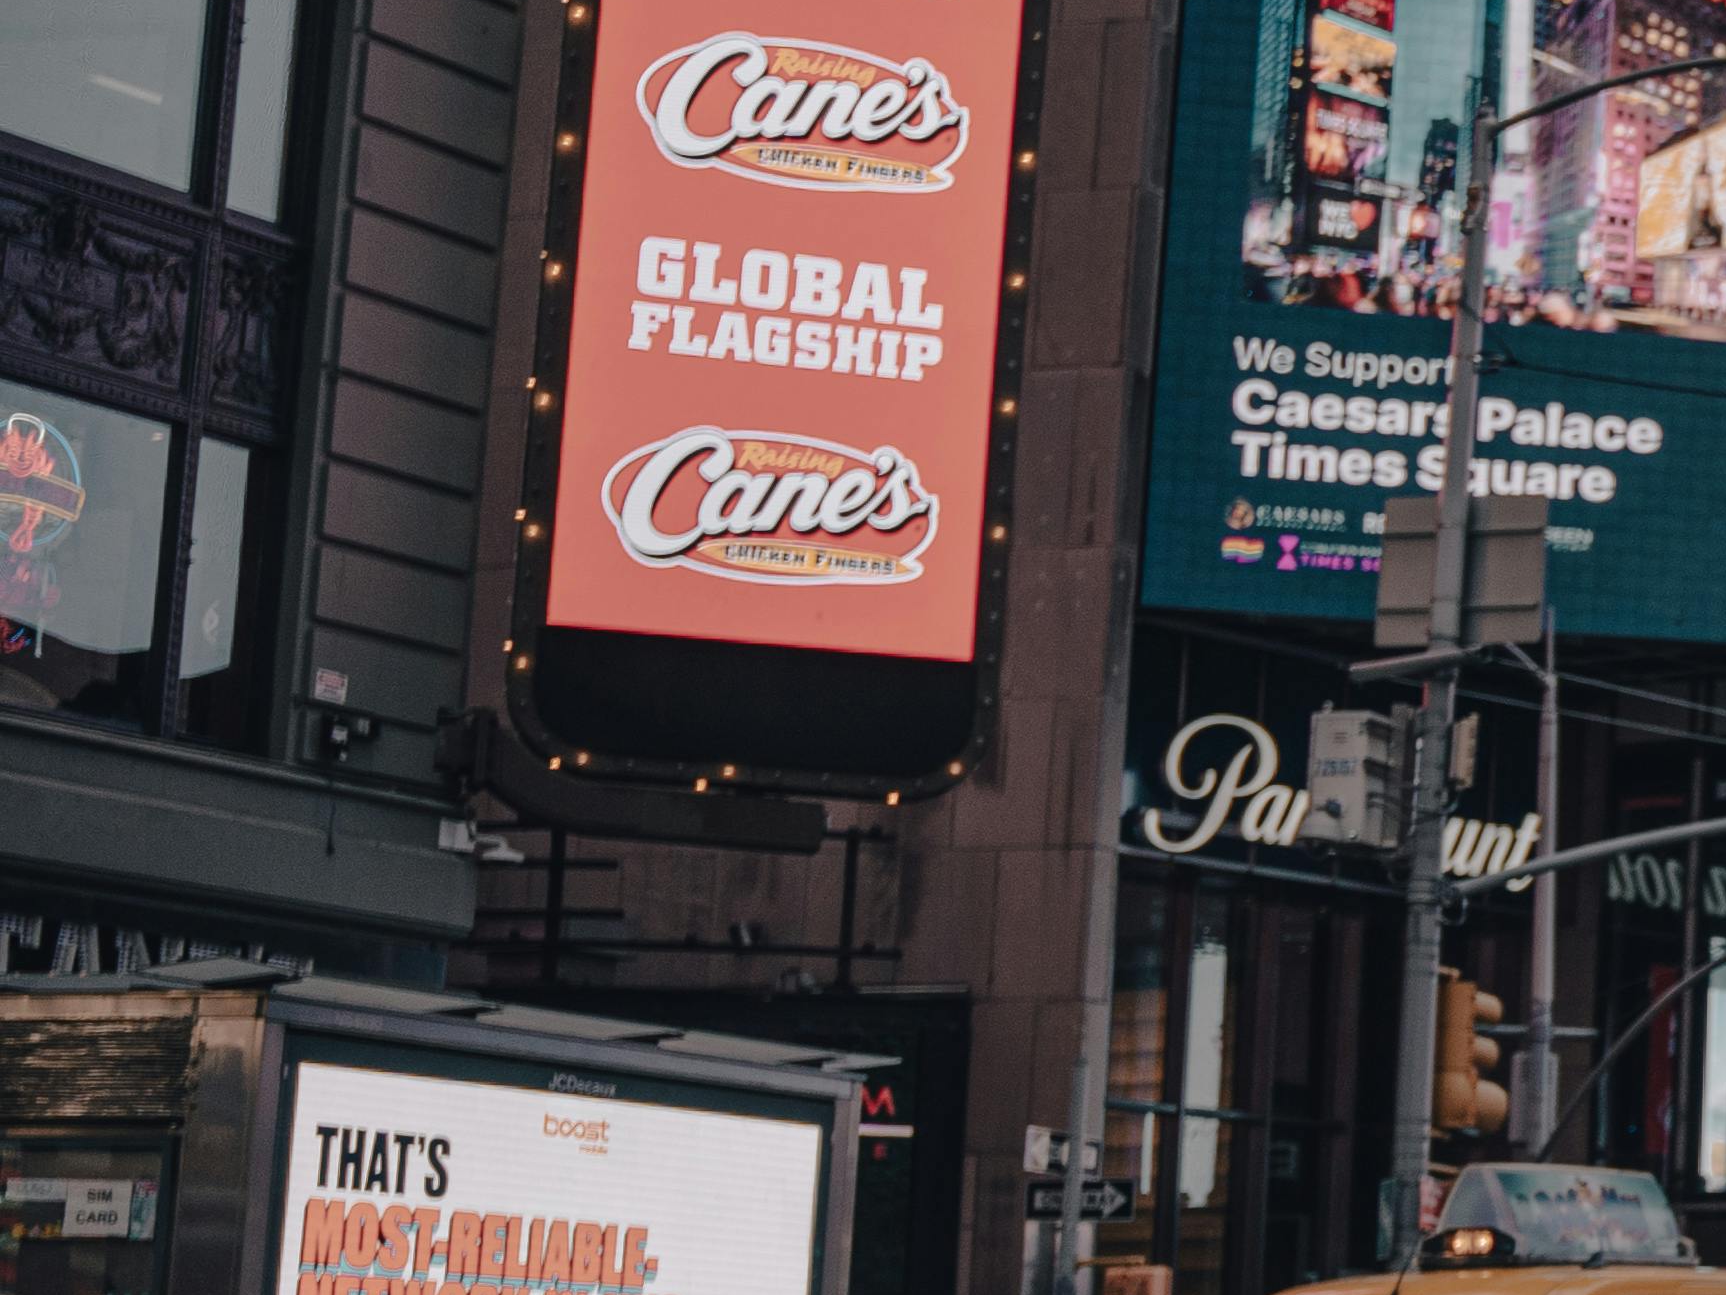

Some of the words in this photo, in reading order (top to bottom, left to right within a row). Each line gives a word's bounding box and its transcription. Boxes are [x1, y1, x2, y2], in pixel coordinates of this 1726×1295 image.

[655, 38, 961, 158] Cane's
[771, 47, 879, 89] Raising
[636, 236, 944, 330] GLOBAL
[627, 299, 943, 382] FLAGSHIP
[1231, 334, 1297, 375] We
[1231, 377, 1452, 439] Caesars
[1475, 396, 1664, 455] Palace
[738, 440, 846, 477] Raising
[1231, 429, 1409, 489] Times
[620, 432, 930, 556] Cane's
[1143, 712, 1543, 893] Parunt
[547, 1071, 618, 1098] JCDecaux
[315, 1123, 451, 1197] THAT'S
[542, 1111, 610, 1144] boost
[75, 1209, 119, 1225] CARD
[86, 1187, 113, 1203] SIM
[301, 1196, 660, 1291] MOST-RELIABLE-
